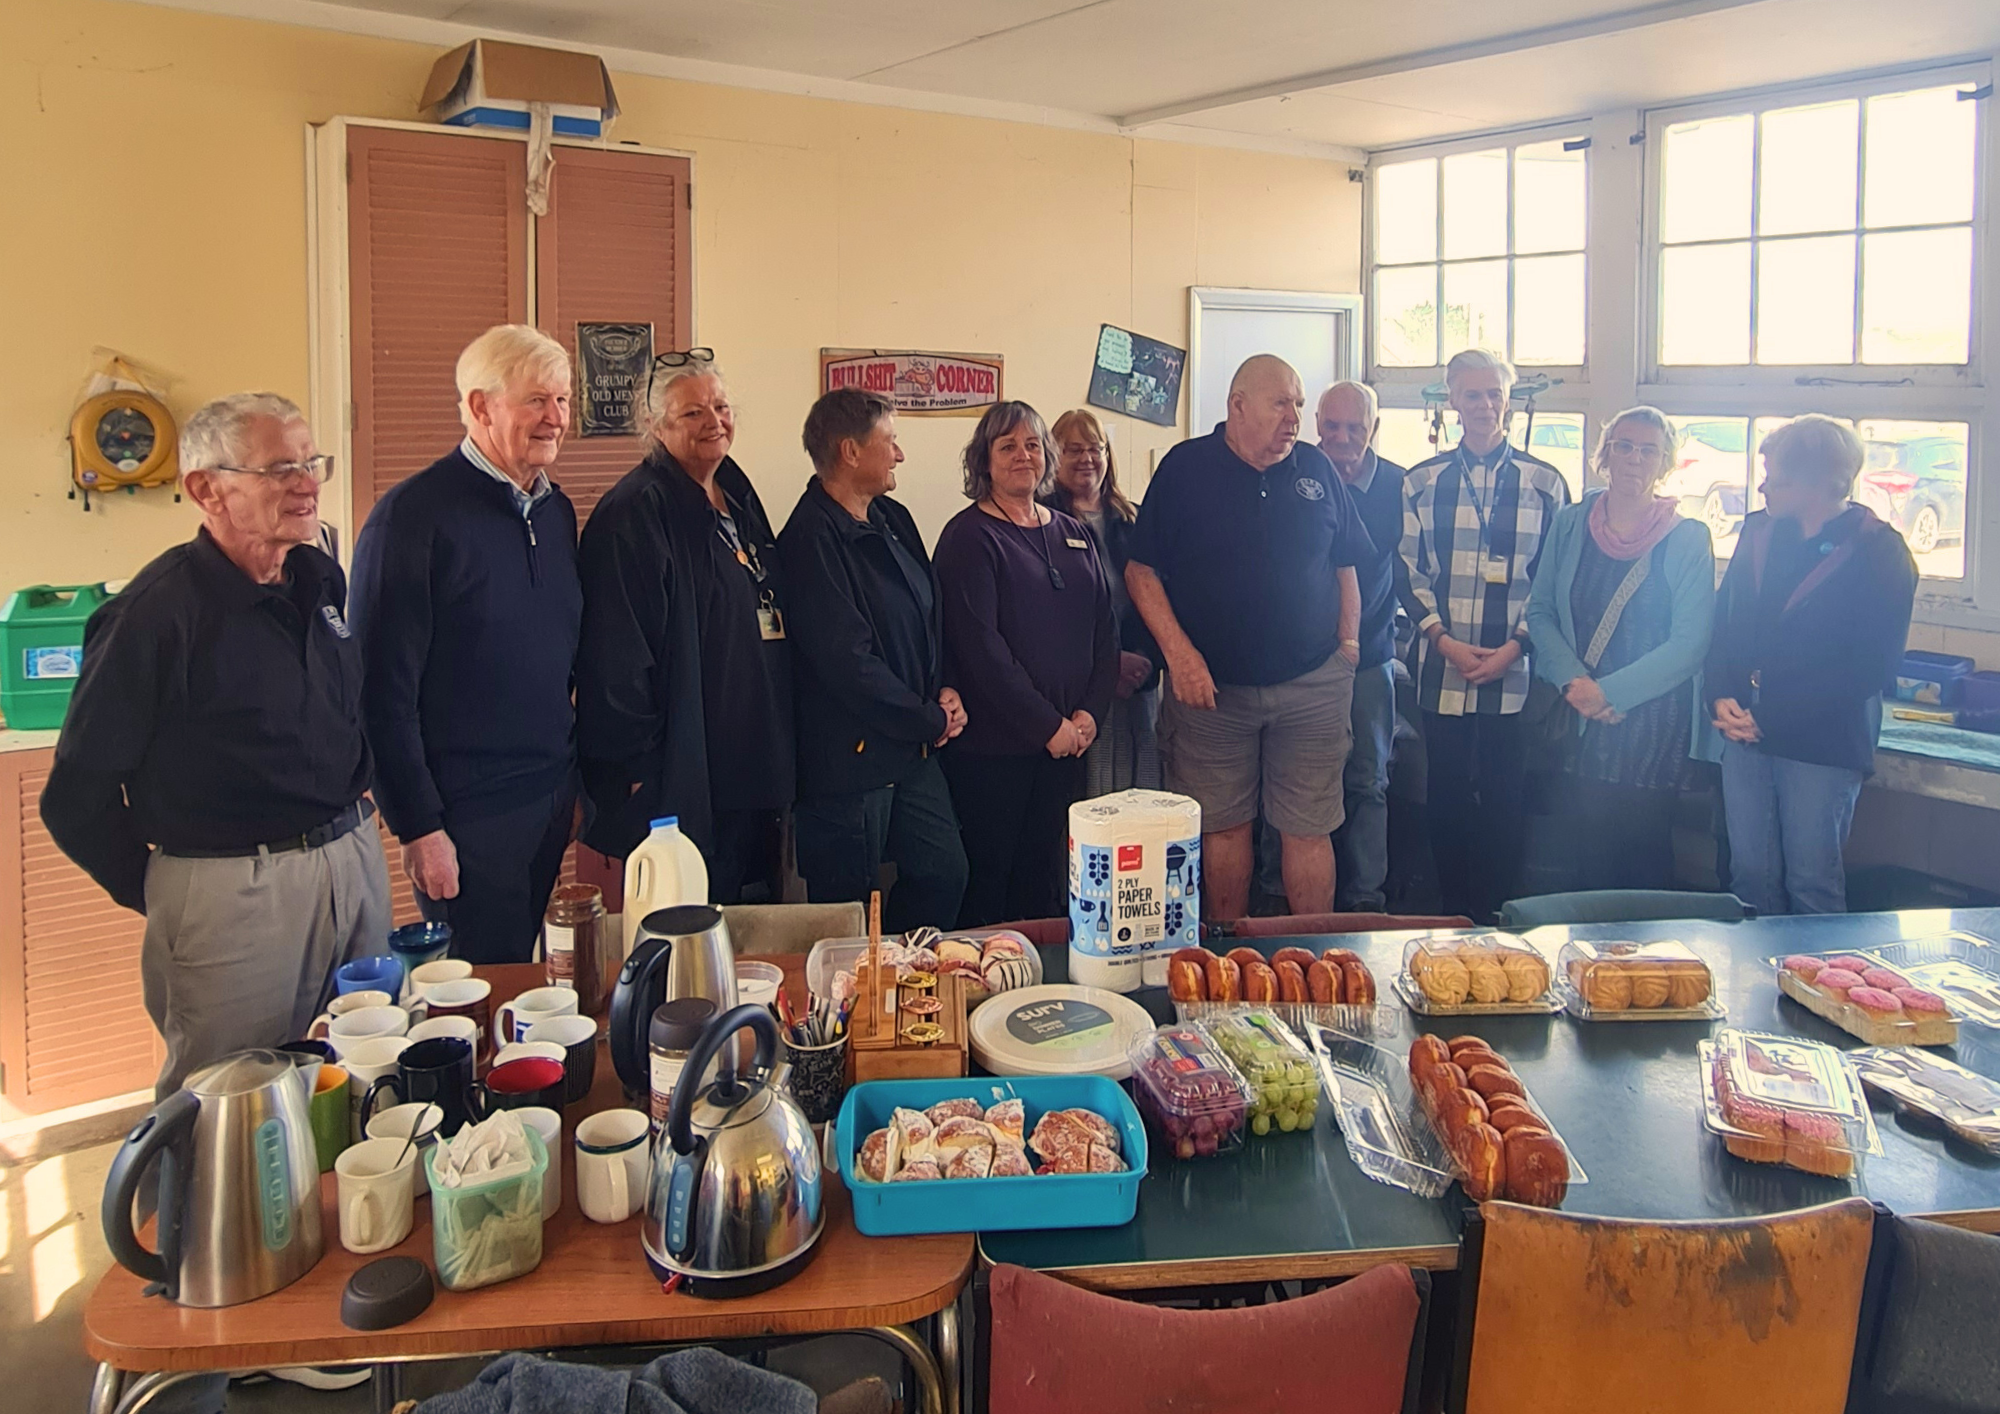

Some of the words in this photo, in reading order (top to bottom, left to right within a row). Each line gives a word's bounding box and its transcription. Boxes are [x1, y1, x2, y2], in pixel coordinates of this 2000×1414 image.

[595, 373, 637, 387] GRUMPY
[831, 363, 896, 392] BULLSHIT
[936, 364, 995, 394] CORNER
[592, 390, 612, 402] OLD
[613, 390, 634, 401] MEN
[911, 399, 927, 407] the
[930, 397, 967, 407] Problem
[603, 405, 629, 417] CLUB
[1118, 879, 1123, 889] 2
[1125, 877, 1140, 888] PLY
[1118, 887, 1153, 904] PAPER
[1118, 901, 1161, 920] TOWELS
